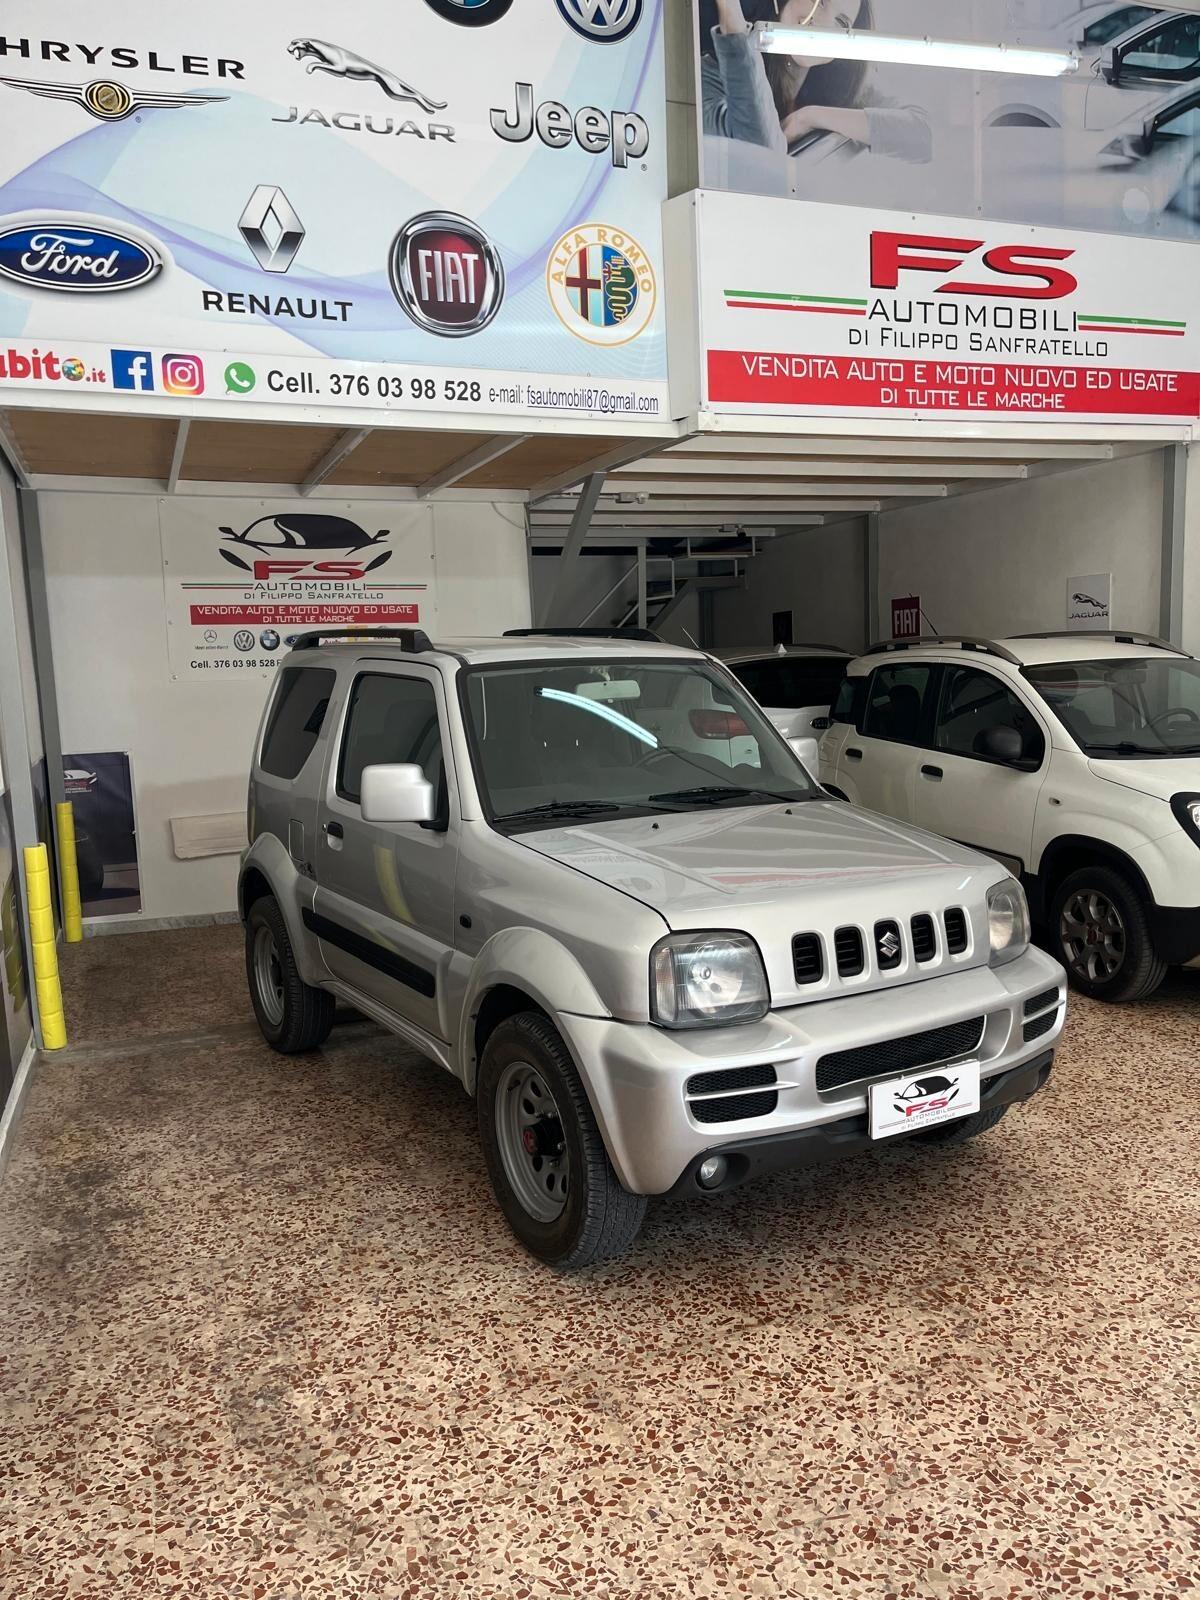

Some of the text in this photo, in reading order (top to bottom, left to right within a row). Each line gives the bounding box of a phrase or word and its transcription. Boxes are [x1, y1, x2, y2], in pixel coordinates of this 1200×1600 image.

[0, 36, 246, 80] HRYSLER
[271, 106, 457, 143] JAGUAR
[489, 81, 650, 168] Jeep
[20, 232, 120, 279] Ford
[551, 227, 653, 294] ALFA ROMEO
[869, 230, 1078, 300] FS
[417, 248, 479, 304] FIAT
[202, 289, 353, 322] RENAULT
[868, 298, 1078, 333] AUTOMOBILI
[849, 327, 1108, 357] DI FILIPPO SANFRATELLO
[0, 347, 106, 383] bito.it
[741, 354, 1178, 392] VENDITA AUTO E MOTO NUOVO ED USATE
[266, 369, 659, 414] Cell. 376 03 98 528 e-mail: fsautomobili87@gmail.com
[880, 386, 1066, 409] DI TUTTE LE MARCHE
[253, 560, 366, 581] FS
[254, 582, 366, 591] AUTOMOBILI
[197, 605, 413, 615] VENDITA AUTO E MOTO NUOVO ED USATE
[244, 592, 255, 600] DI
[262, 615, 272, 623] DI
[275, 615, 302, 623] TUTTE
[305, 615, 316, 623] LE
[893, 608, 918, 635] FIAT
[1068, 610, 1109, 619] JAGUAR
[190, 660, 212, 669] Cell.
[214, 660, 230, 668] 376
[232, 660, 244, 668] 03
[246, 660, 257, 668] 98
[259, 659, 276, 668] 528
[905, 1096, 949, 1117] FS
